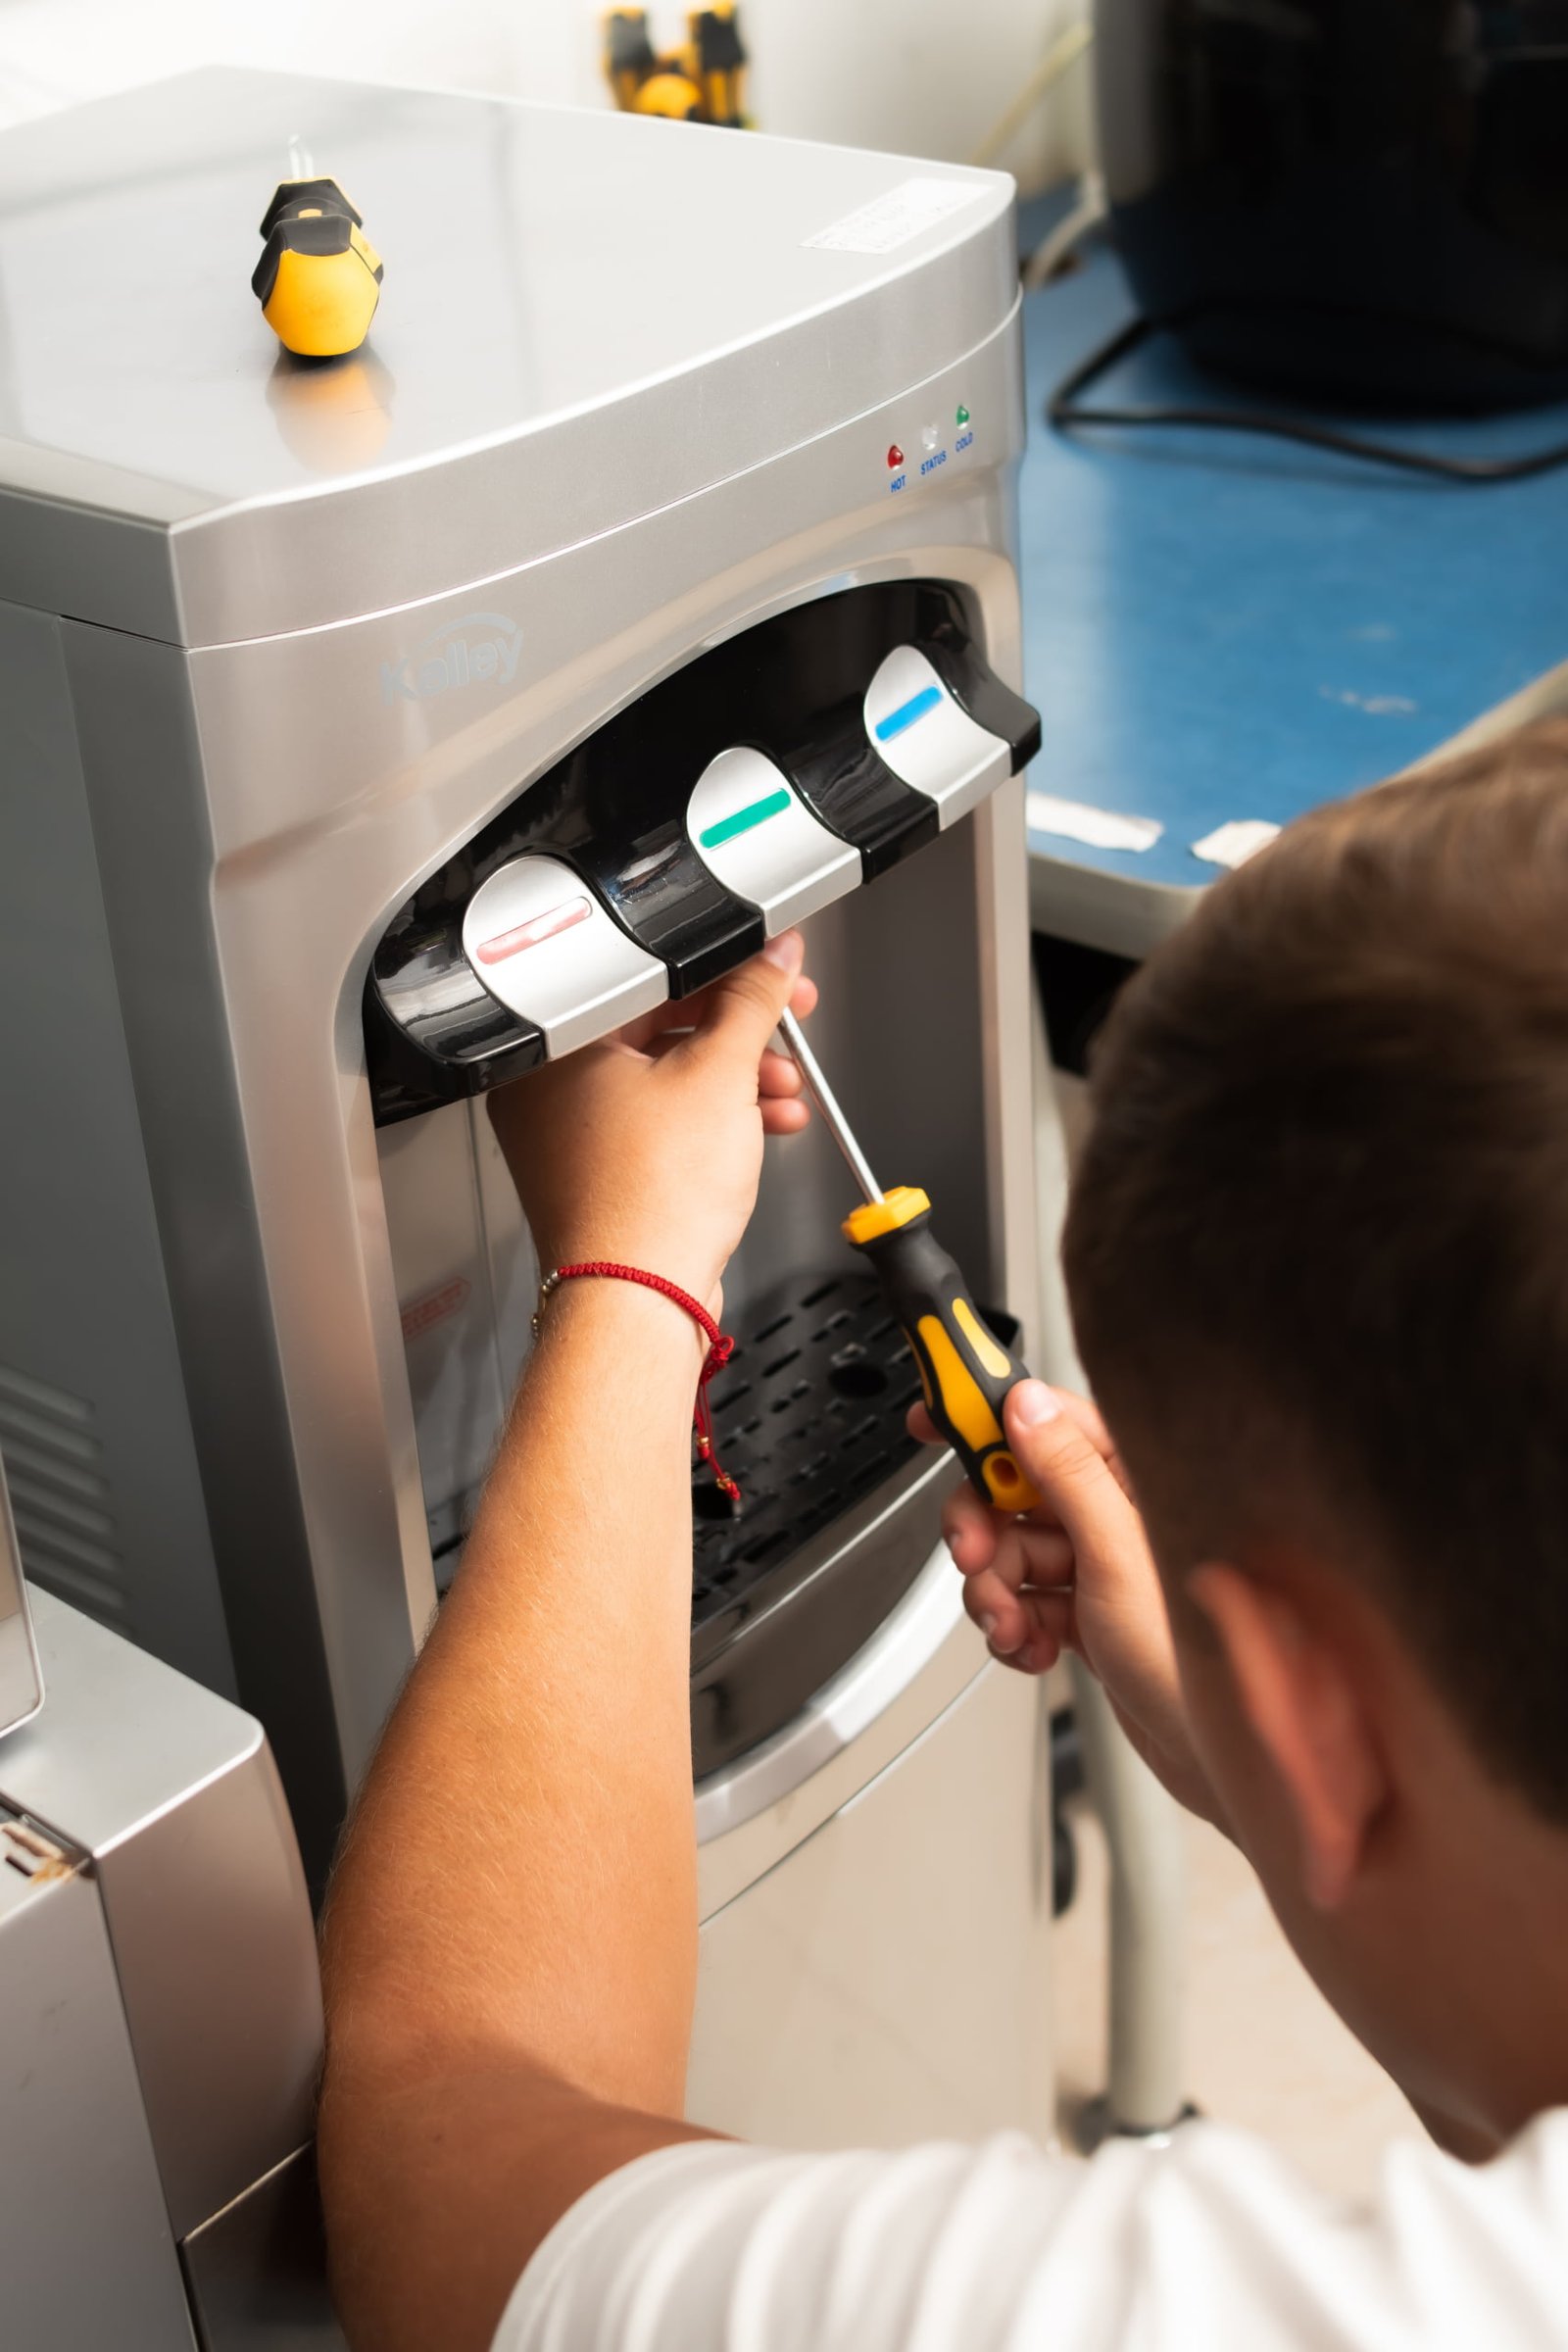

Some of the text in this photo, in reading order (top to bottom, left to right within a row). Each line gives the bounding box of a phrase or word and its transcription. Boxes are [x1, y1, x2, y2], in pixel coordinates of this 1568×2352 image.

[956, 431, 973, 453] COLD
[920, 450, 947, 475] STATUS
[890, 474, 906, 493] HOT
[379, 628, 524, 707] Kalley
